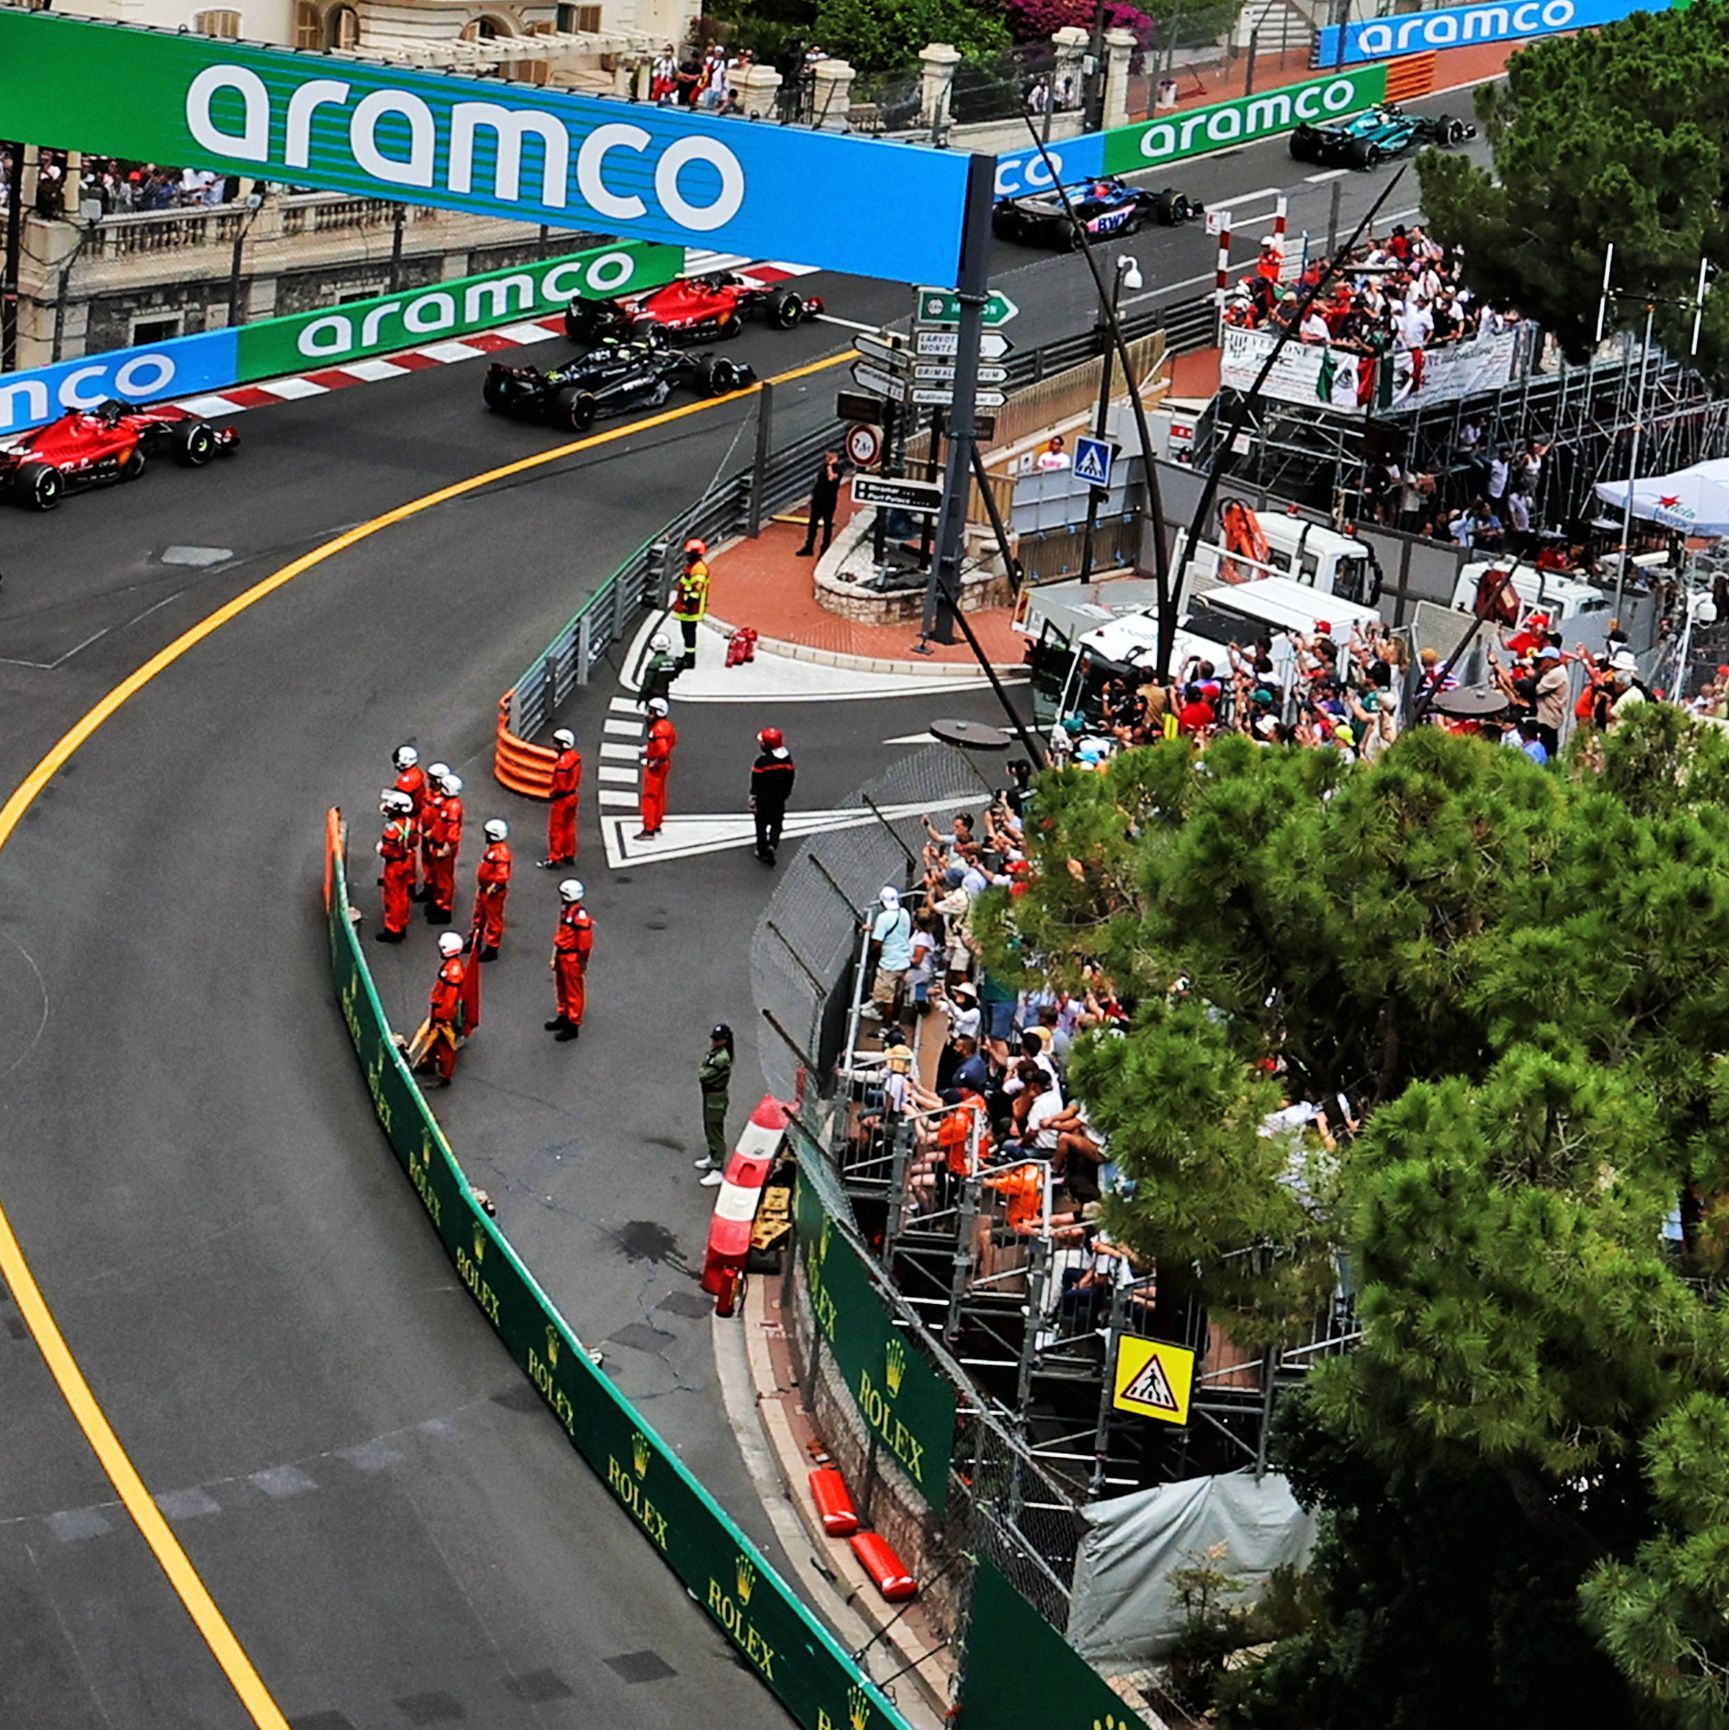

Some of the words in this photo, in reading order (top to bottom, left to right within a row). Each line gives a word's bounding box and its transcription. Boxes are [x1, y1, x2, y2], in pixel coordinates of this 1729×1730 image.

[1358, 0, 1575, 53] aramco
[184, 64, 745, 231] aramco
[1140, 80, 1355, 157] aramco
[297, 252, 635, 357] aramco
[921, 334, 956, 342] LARVOT
[917, 368, 956, 377] GRIMAL
[457, 1245, 501, 1328] ROLEX
[527, 1348, 576, 1437] ROLEX
[859, 1369, 924, 1483] ROLEX
[608, 1454, 669, 1552] ROLEX
[708, 1578, 776, 1682] ROLEX
